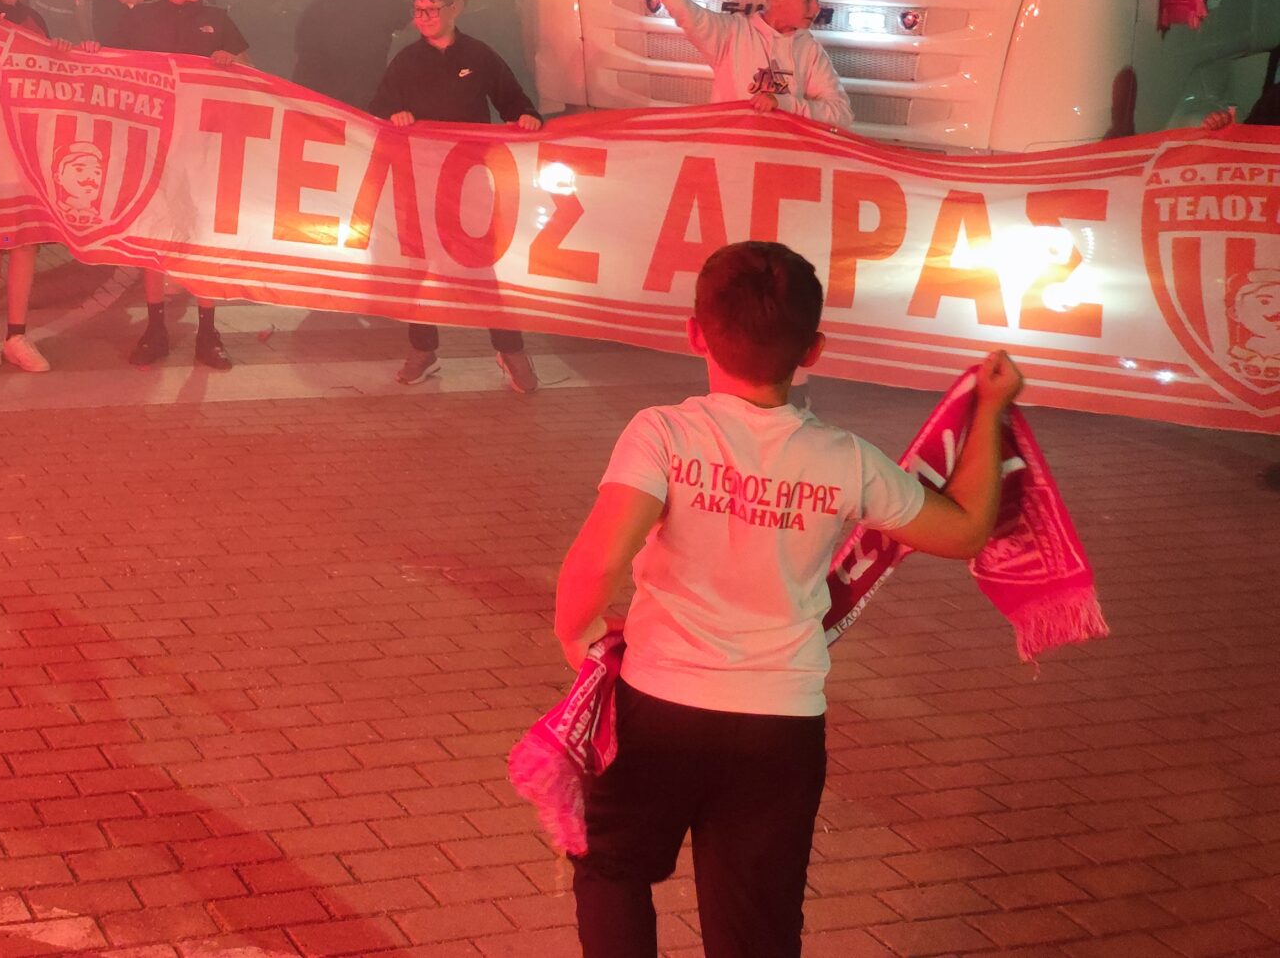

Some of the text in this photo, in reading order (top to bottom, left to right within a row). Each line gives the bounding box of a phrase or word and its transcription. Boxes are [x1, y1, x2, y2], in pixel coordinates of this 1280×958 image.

[7, 77, 165, 120] ΤΕΛΟΣ ΑΓΡΑΣ
[199, 97, 1110, 338] ΤΕΛΟΣ ΑΓΡΑΣ
[1154, 193, 1267, 223] ΤΕΛΟΣ
[690, 491, 805, 531] ΑΚΑΔΗΜΙΑ
